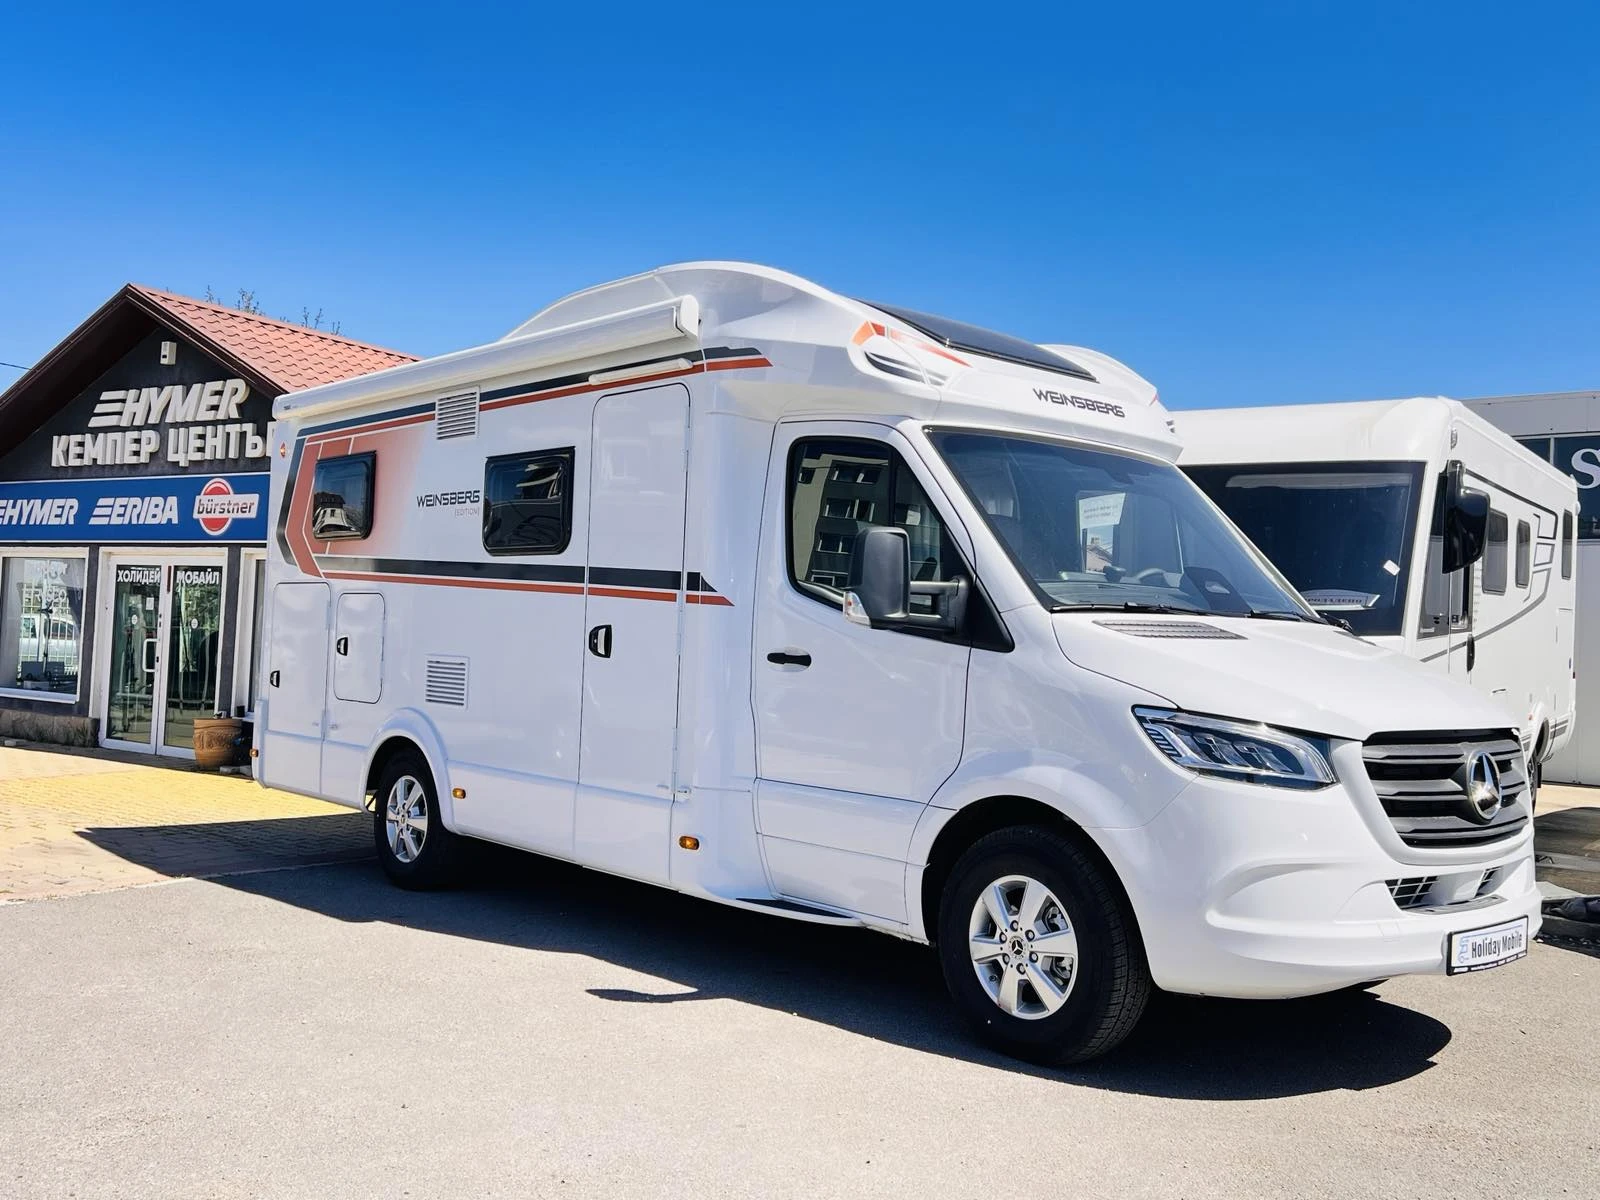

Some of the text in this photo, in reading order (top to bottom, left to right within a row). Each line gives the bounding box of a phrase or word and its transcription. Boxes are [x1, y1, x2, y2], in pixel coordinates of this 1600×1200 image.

[120, 378, 250, 427] HYMER
[1033, 388, 1126, 418] WEINSBERG
[51, 430, 160, 467] КЕМПЕР
[3, 498, 79, 525] HYMER
[109, 496, 179, 525] ERIBA
[197, 497, 255, 515] bürstner
[417, 490, 480, 508] WEINSBERG
[117, 567, 220, 585] ХОЛИДЕЙ МОБАЙЛ
[1472, 931, 1522, 957] Holiday Mobile
